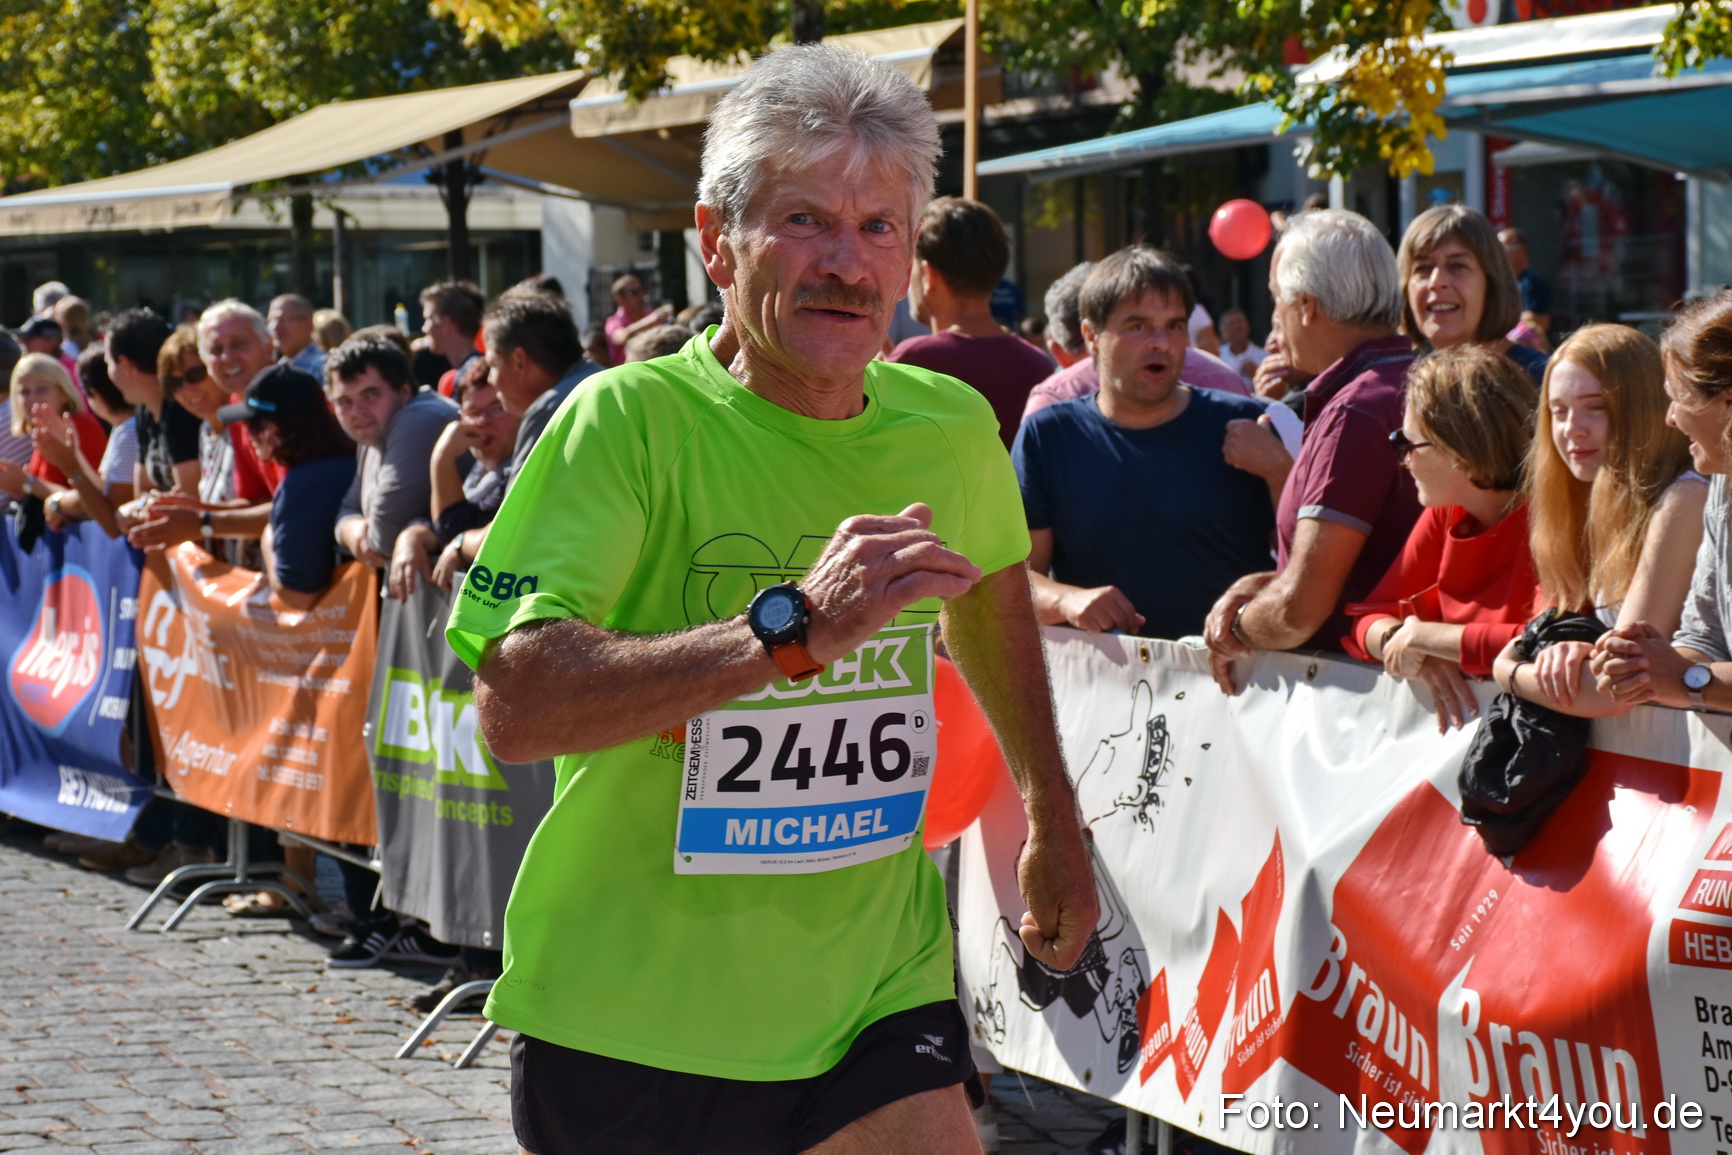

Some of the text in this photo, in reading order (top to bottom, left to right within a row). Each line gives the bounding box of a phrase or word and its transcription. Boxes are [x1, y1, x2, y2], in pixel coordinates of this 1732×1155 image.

[460, 588, 482, 604] ster
[914, 715, 925, 729] D
[173, 730, 238, 776] Agentur
[716, 712, 911, 792] 2446
[724, 807, 889, 846] MICHAEL
[1450, 889, 1498, 951] Seit 1929
[1298, 922, 1430, 1091] Braun
[1345, 1041, 1384, 1082] Sicher
[1383, 1072, 1402, 1097] ist
[1438, 986, 1647, 1140] Braun
